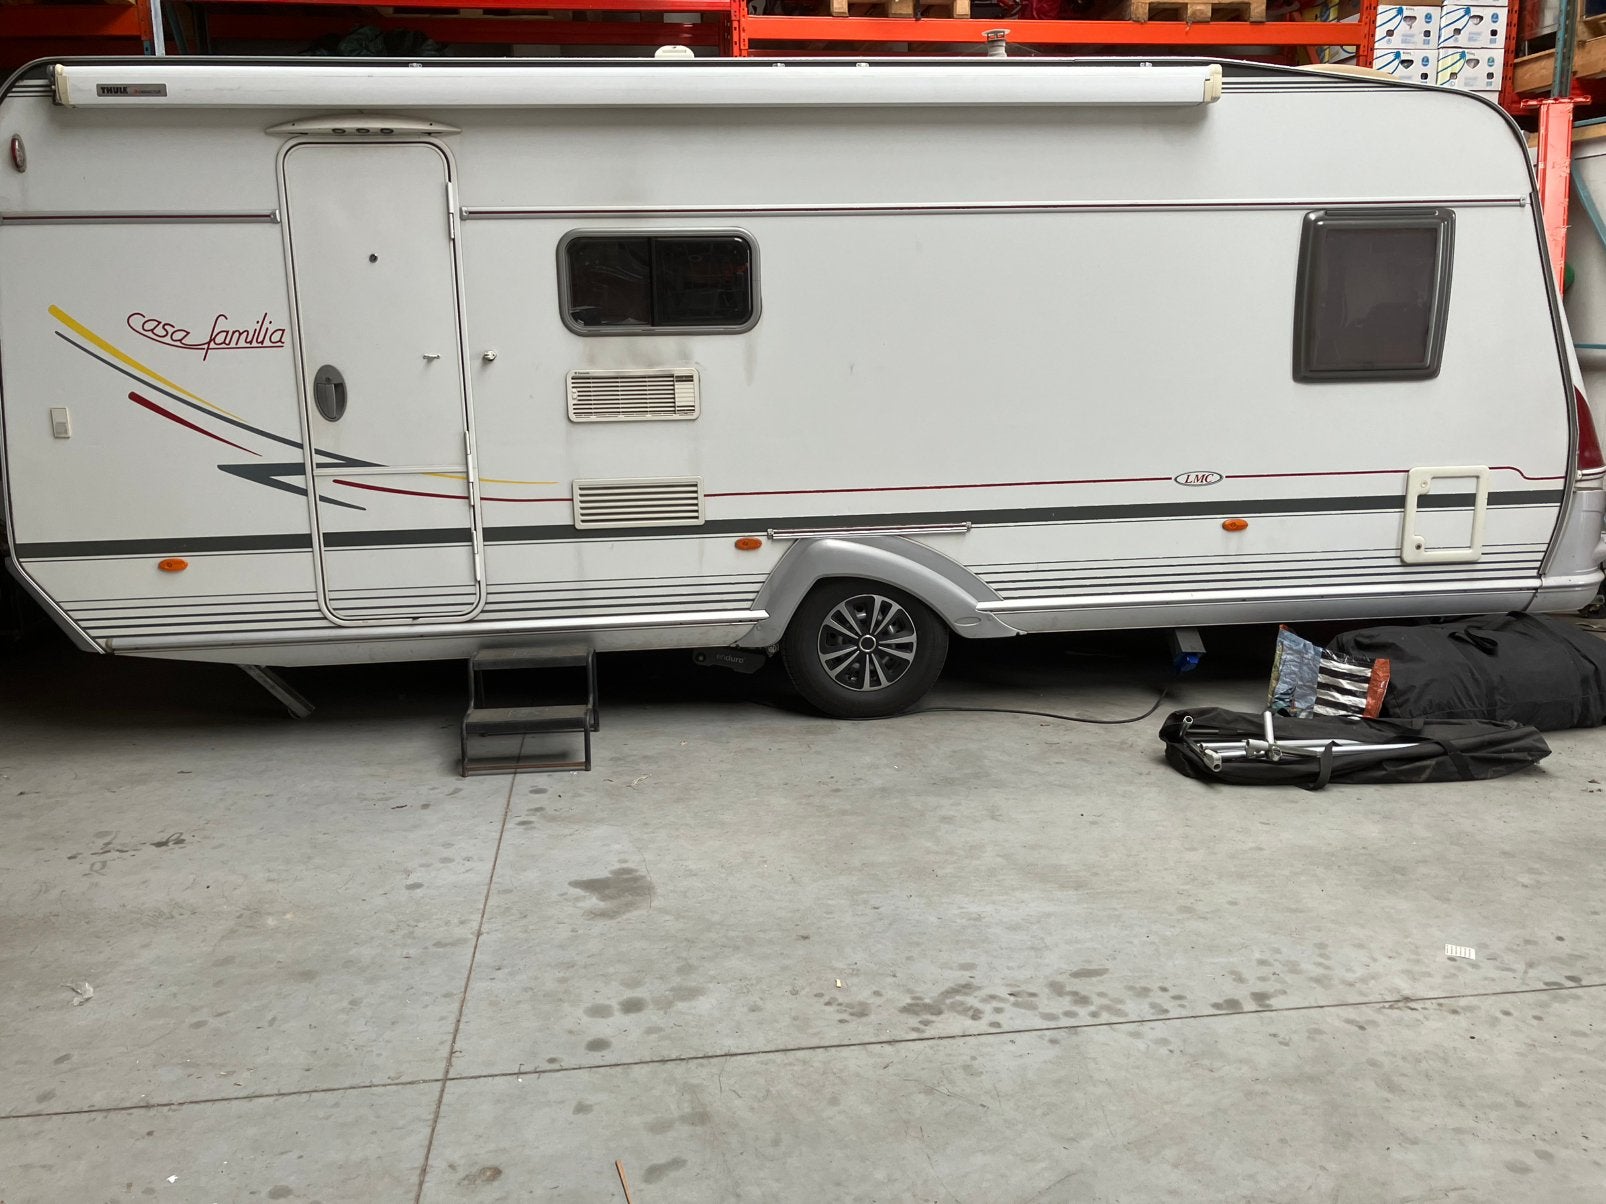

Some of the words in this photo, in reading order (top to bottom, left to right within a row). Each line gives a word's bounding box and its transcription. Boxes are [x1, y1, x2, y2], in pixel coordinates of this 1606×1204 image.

[101, 86, 128, 94] THULE
[202, 312, 286, 361] familia
[1184, 473, 1214, 484] LMC
